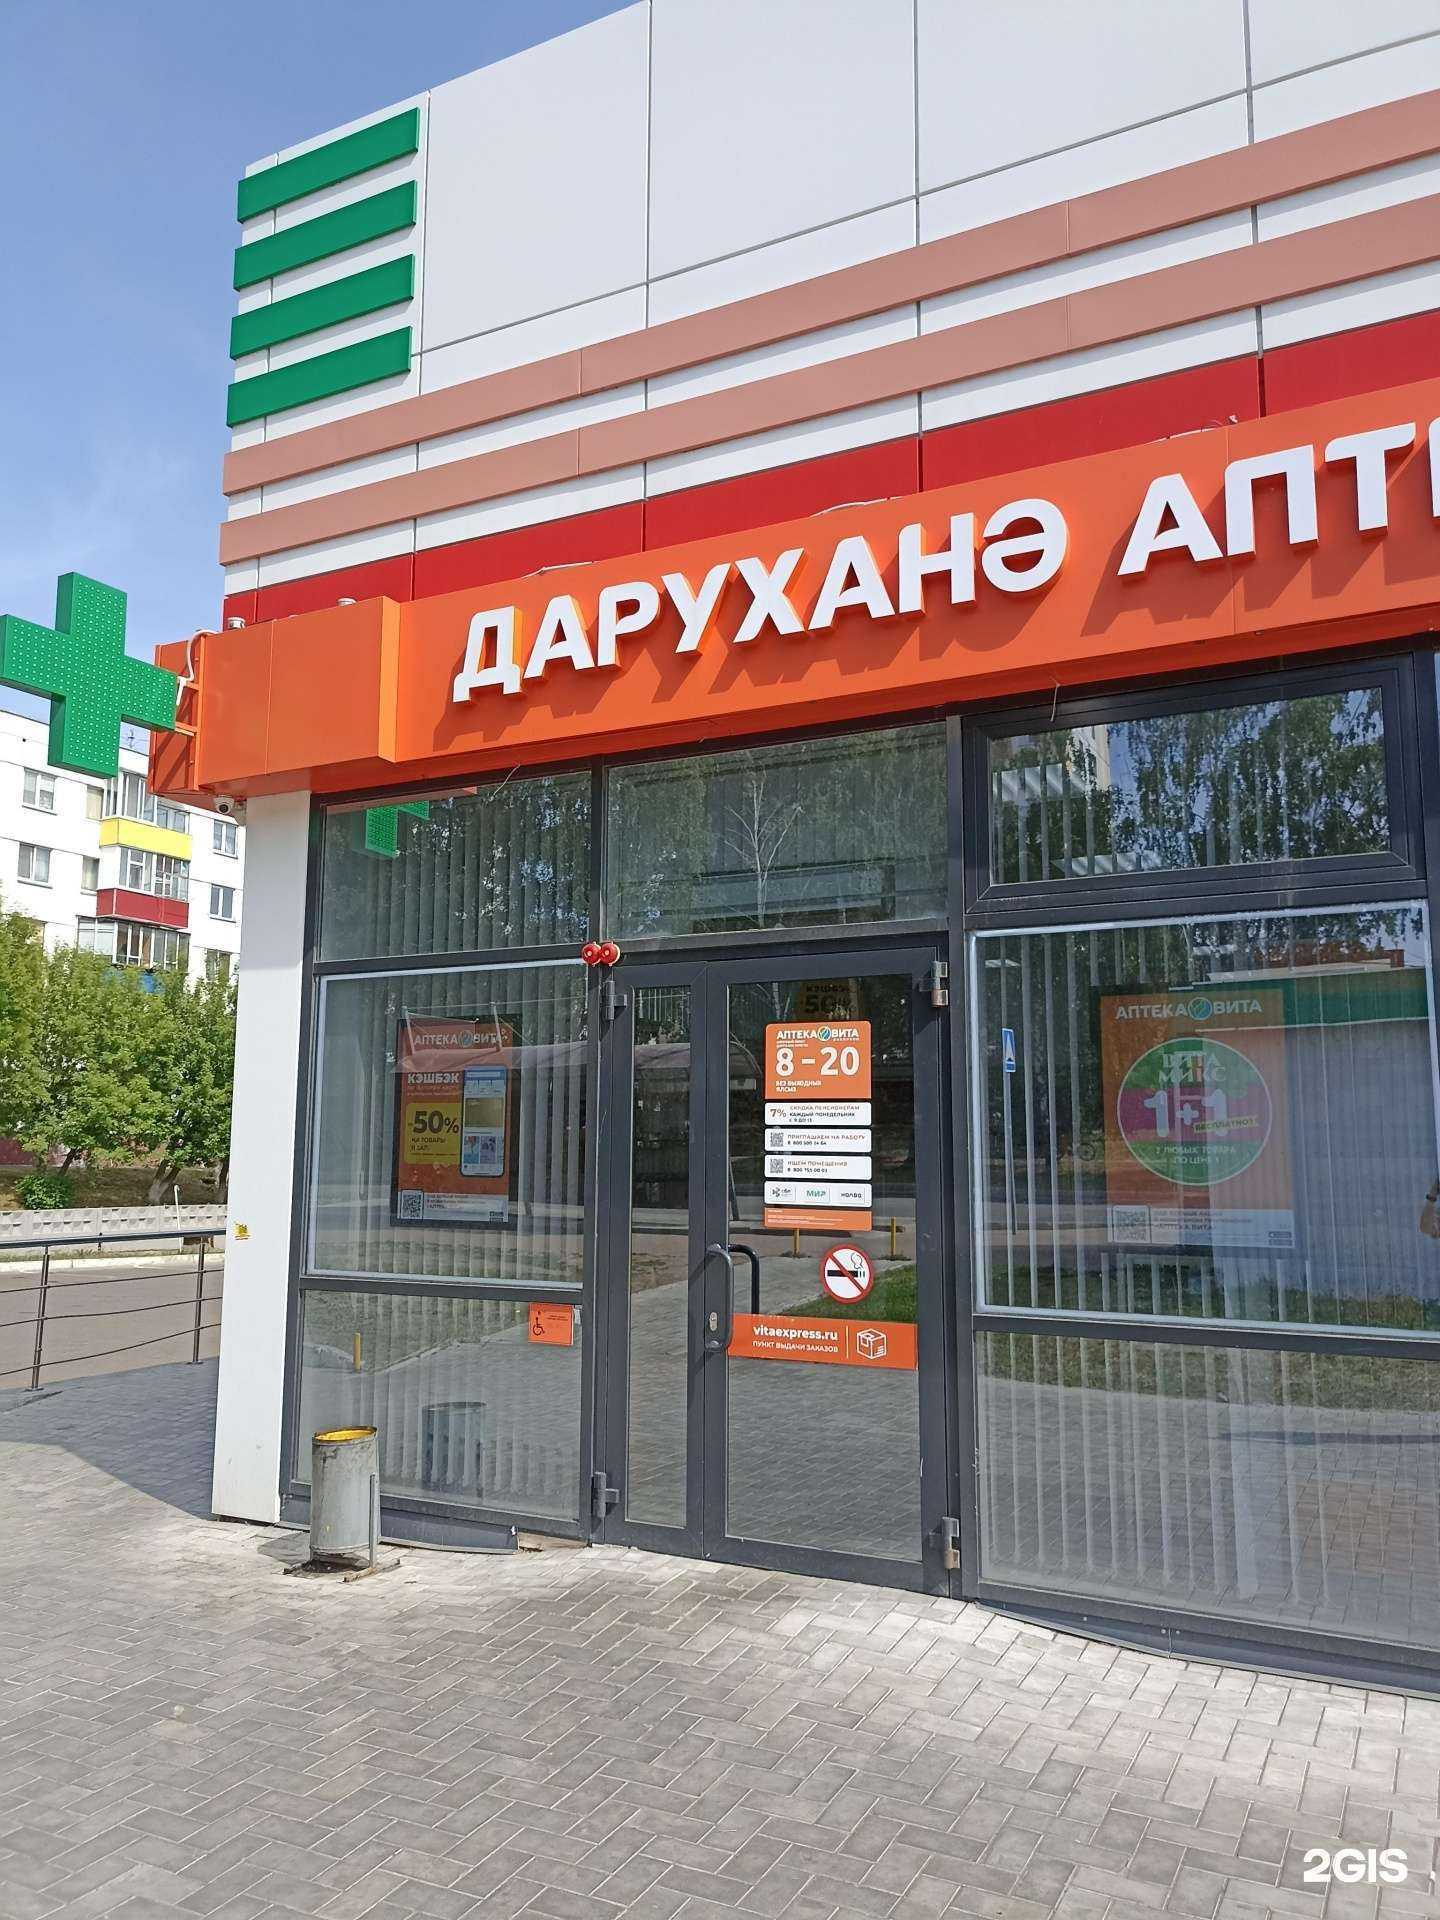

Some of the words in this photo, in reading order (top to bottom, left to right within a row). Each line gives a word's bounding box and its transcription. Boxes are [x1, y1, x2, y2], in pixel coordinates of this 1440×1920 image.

[453, 498, 1070, 704] ДАРУХАНӘ
[1115, 1002, 1188, 1019] АПТЕКА
[1212, 999, 1263, 1014] ВИТА
[414, 1034, 458, 1046] АПТЕКА
[776, 1029, 818, 1040] АПТЕКА
[831, 1028, 860, 1039] ВИТА
[407, 1072, 459, 1085] КЭШБЭК
[770, 1107, 787, 1118] 7%
[1143, 1089, 1229, 1138] 1+1
[806, 1190, 826, 1198] МИР
[753, 1324, 838, 1341] vitaexpress.ru
[752, 1340, 774, 1349] ПУНКТ
[775, 1342, 806, 1351] ВЫДАЧИ
[806, 1343, 839, 1353] ЗАКАЗОВ
